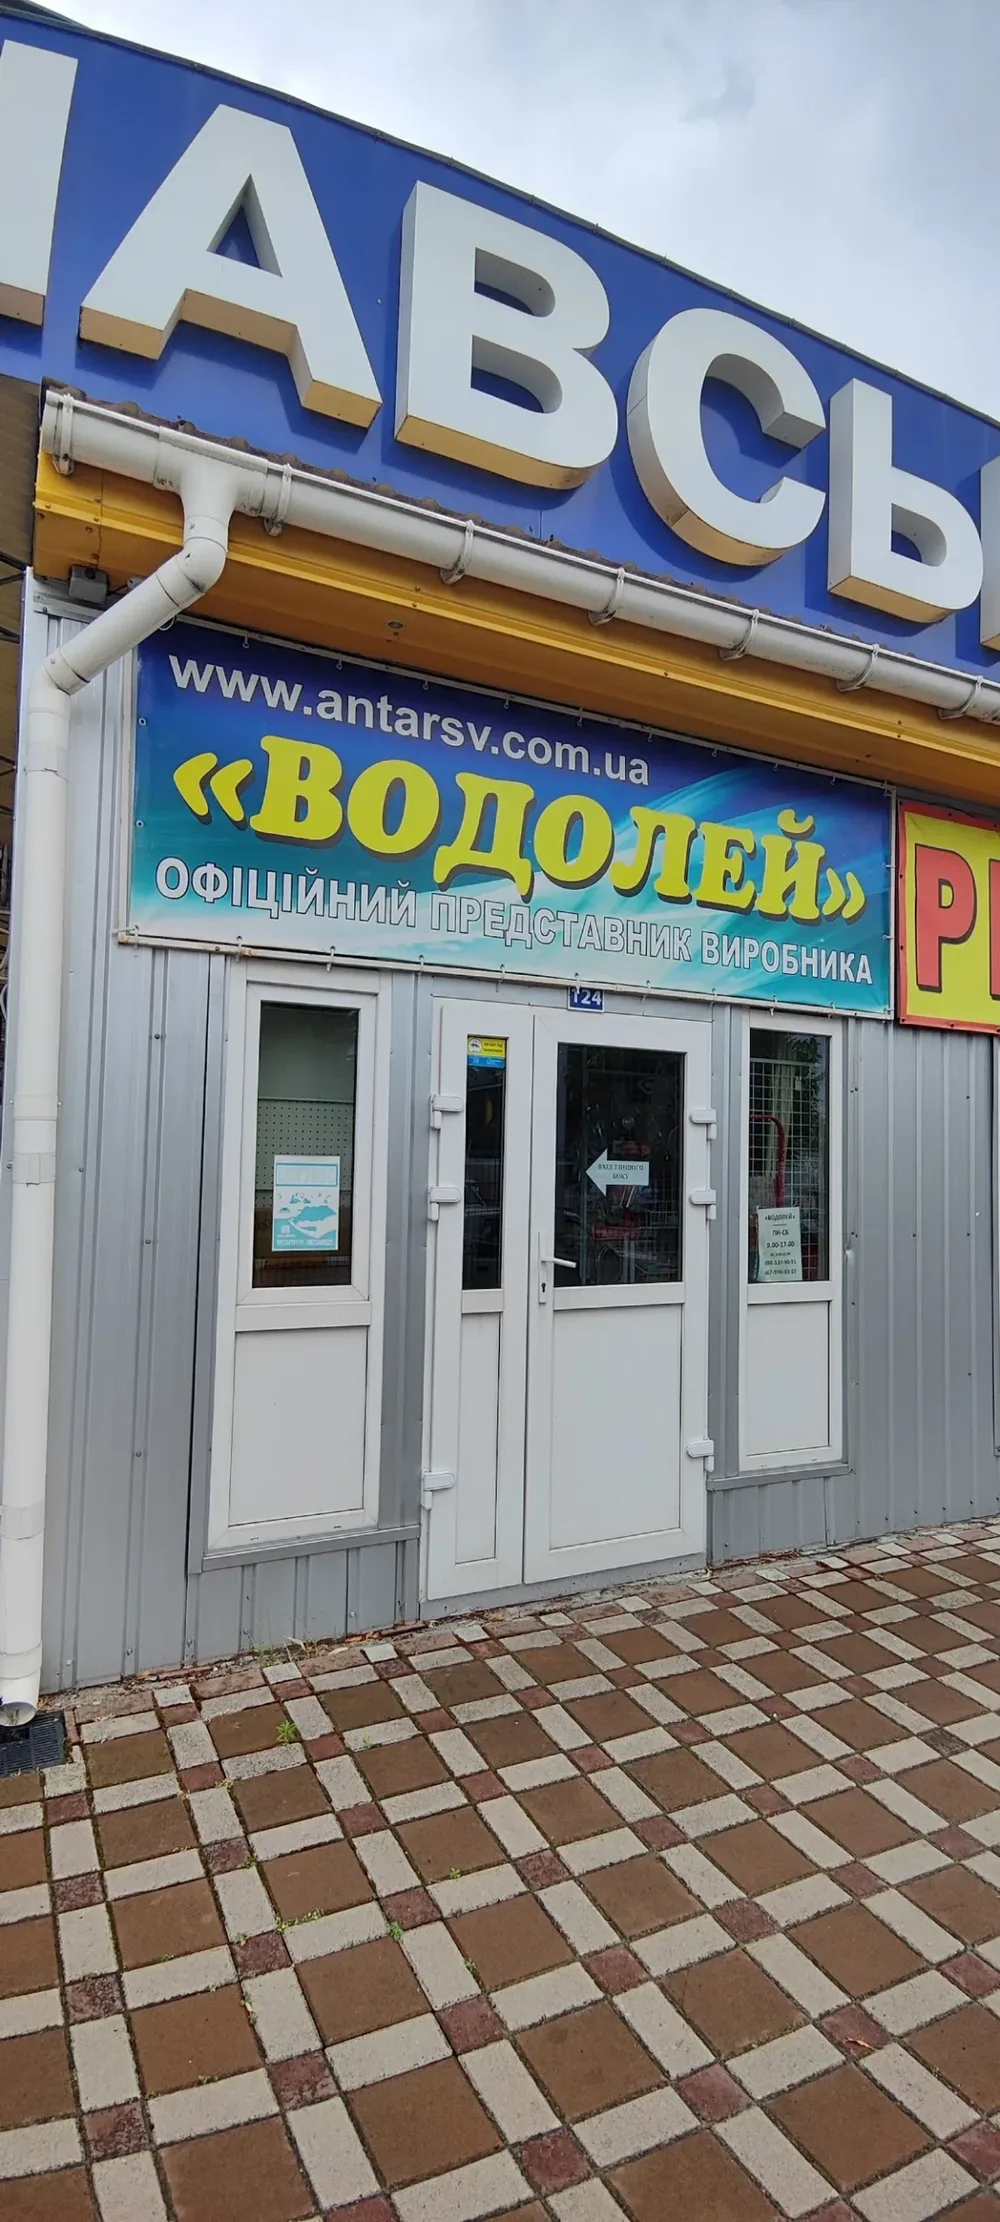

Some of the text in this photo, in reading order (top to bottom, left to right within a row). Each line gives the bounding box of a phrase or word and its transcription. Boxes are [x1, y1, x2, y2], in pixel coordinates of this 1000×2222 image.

[0, 38, 1000, 651] АВСЬ
[168, 654, 650, 786] www.antarsv.com.ua
[173, 734, 868, 923] «ВОДОЛЕЙ»
[155, 856, 873, 985] ОФІЦІЙНИЙ ПРЕДСТАВНИК ВИРОБНИКА
[571, 988, 602, 1006] 124
